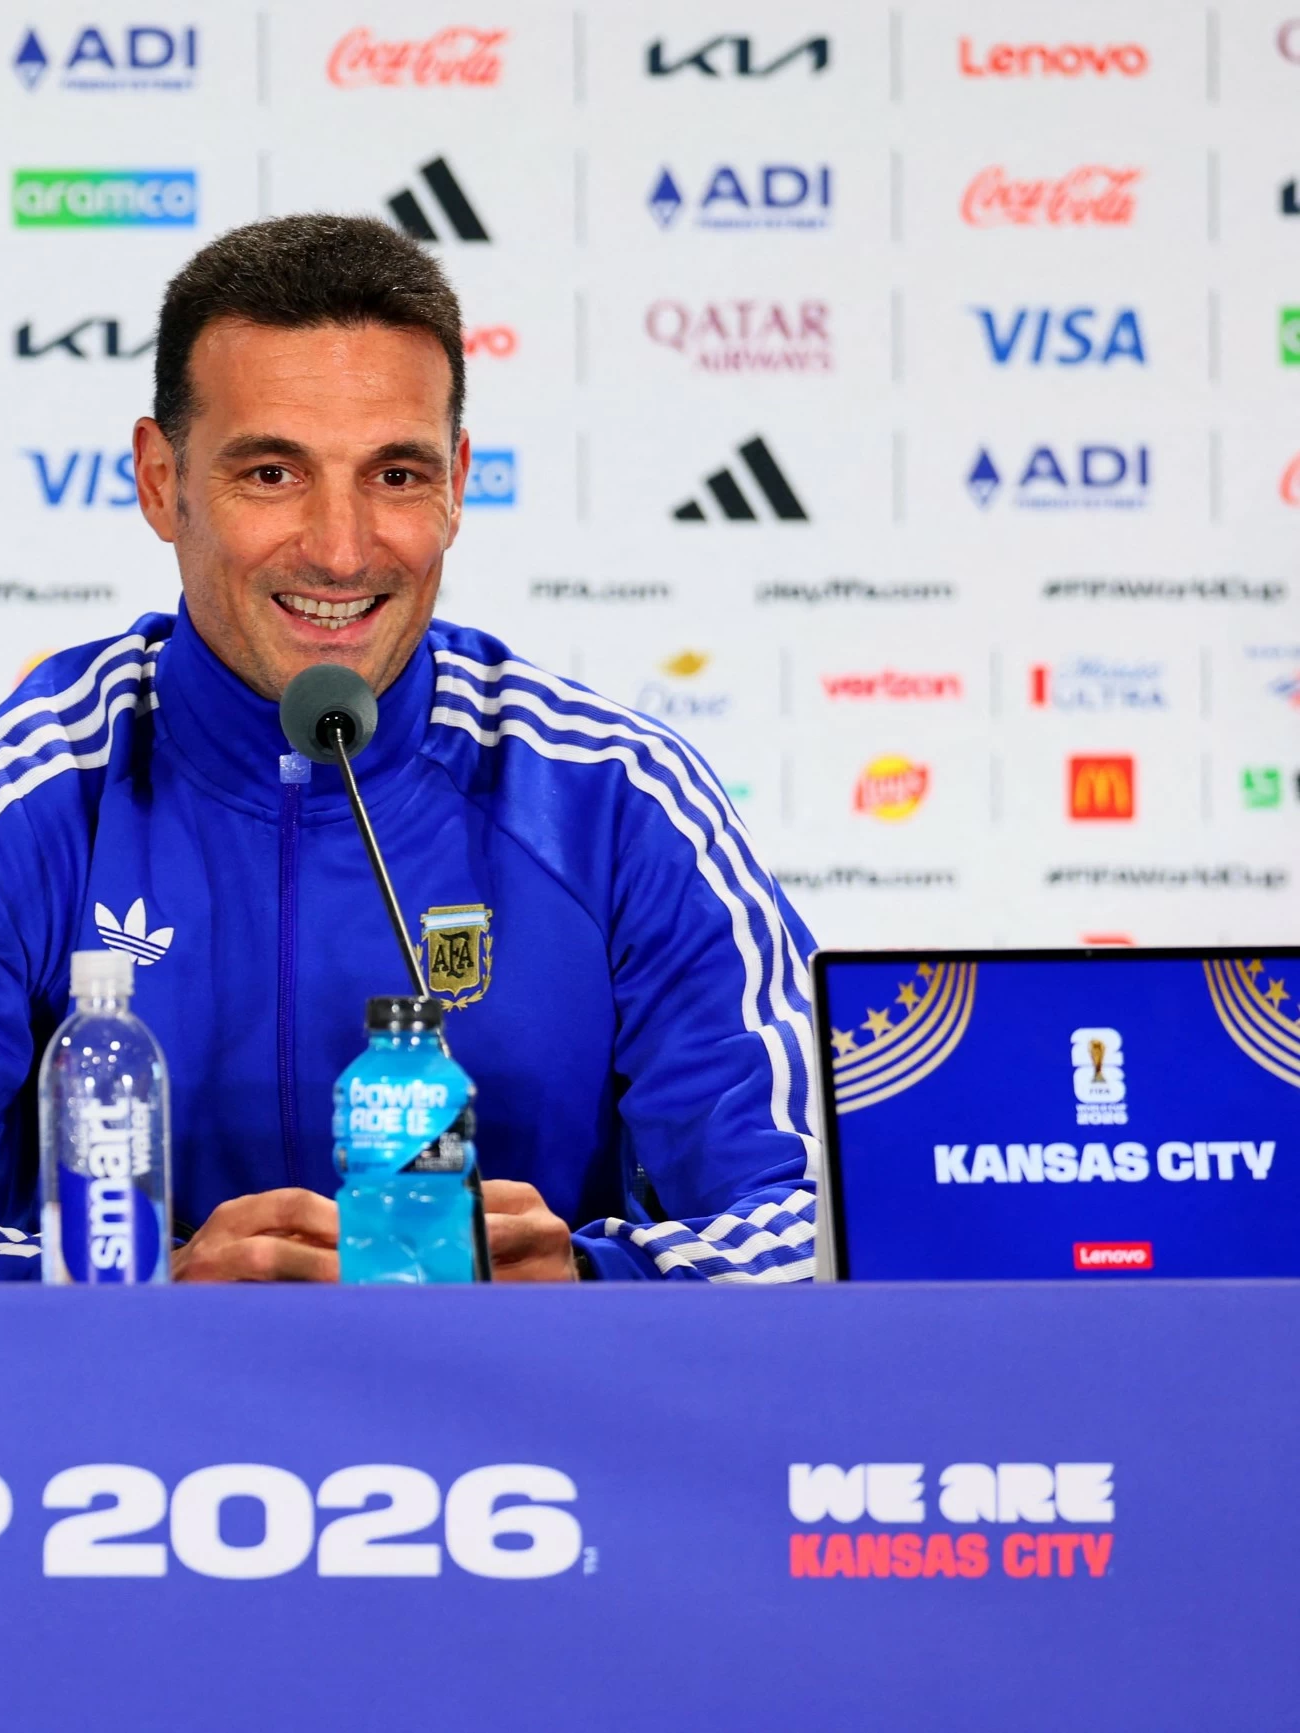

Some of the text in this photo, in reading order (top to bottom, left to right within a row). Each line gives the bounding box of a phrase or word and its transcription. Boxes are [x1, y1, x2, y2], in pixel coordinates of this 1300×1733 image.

[66, 27, 196, 70] ADI
[646, 36, 830, 76] KIA
[959, 38, 1148, 77] Lenovo
[13, 178, 195, 217] aramco
[701, 166, 832, 209] ADI
[645, 302, 830, 352] QATAR
[972, 308, 1147, 365] VISA
[22, 450, 136, 507] VIS
[1019, 446, 1149, 488] ADI
[432, 931, 474, 978] AFA
[80, 1096, 132, 1270] smart
[934, 1141, 1276, 1183] KANSAS CITY
[1080, 1247, 1146, 1265] Lenovo
[788, 1463, 926, 1523] WE
[42, 1462, 583, 1580] 2026
[789, 1533, 1114, 1578] KANSAS CITY
